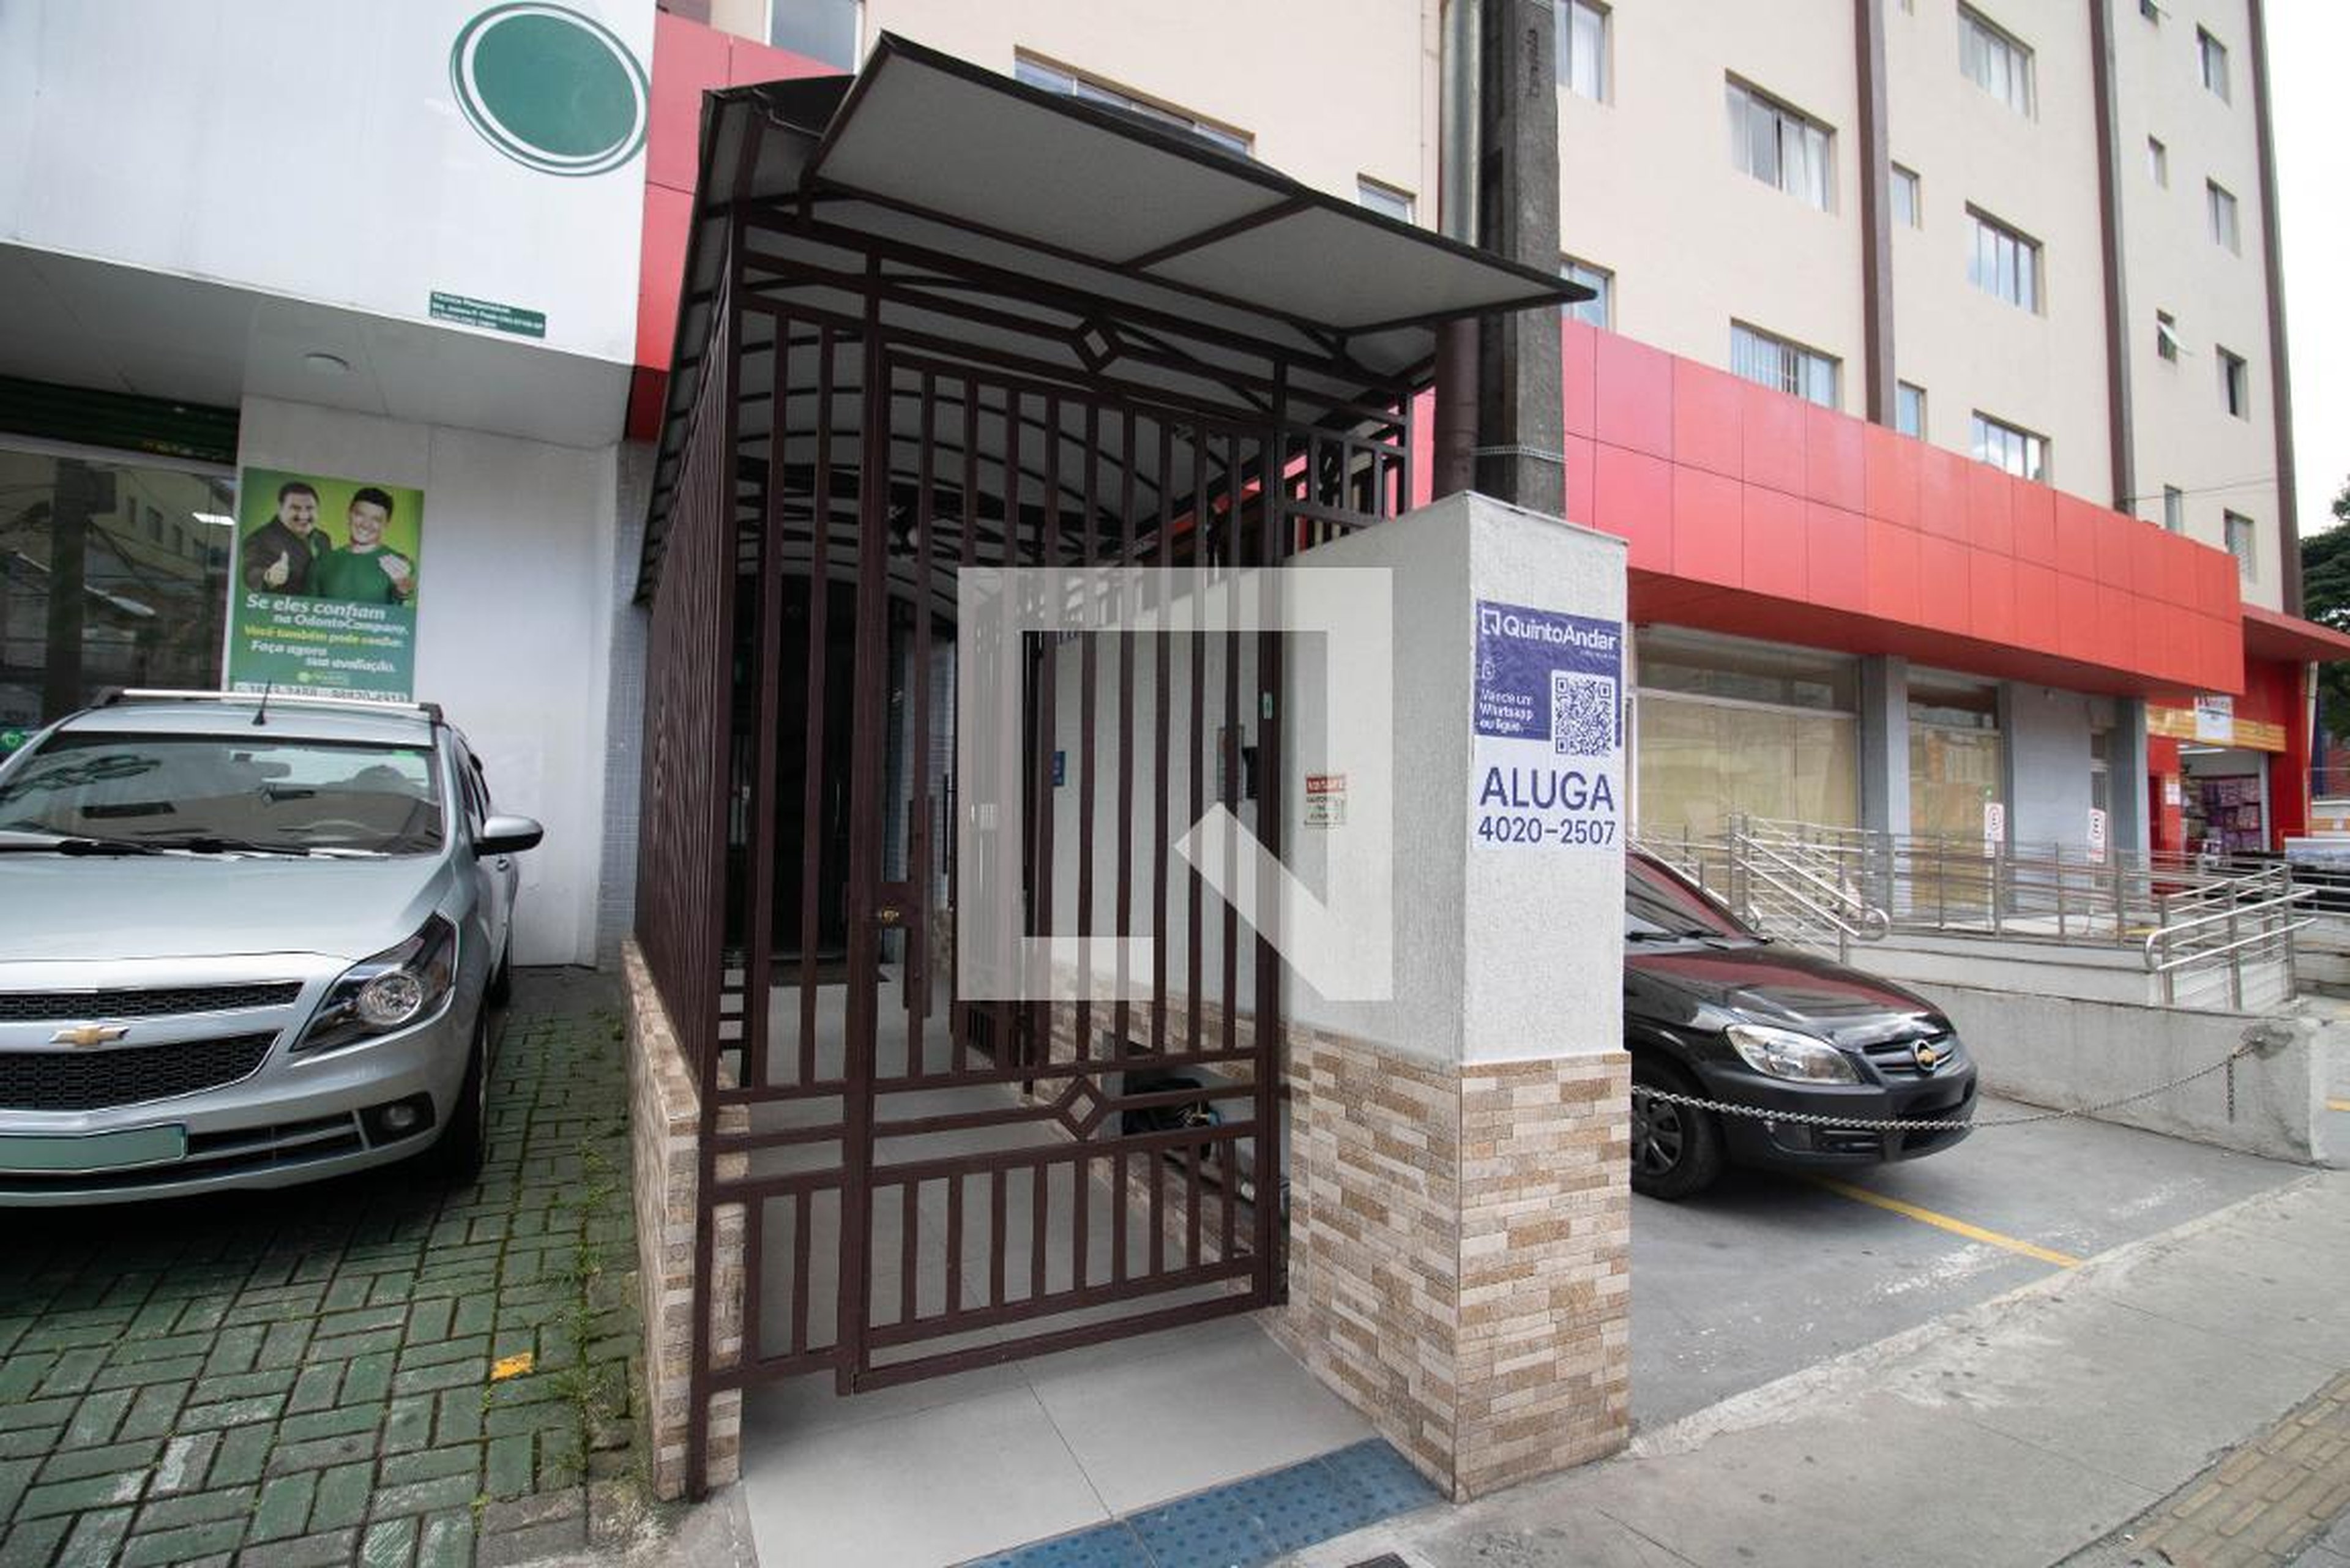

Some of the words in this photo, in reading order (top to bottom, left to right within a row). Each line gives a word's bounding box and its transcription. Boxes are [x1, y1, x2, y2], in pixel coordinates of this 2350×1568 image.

[247, 594, 269, 610] Se
[273, 597, 310, 612] eles
[313, 602, 386, 621] confiam
[273, 614, 291, 625] na
[1503, 615, 1616, 650] QuintoAndar
[251, 640, 284, 654] Faça
[1480, 720, 1494, 730] ou
[1480, 767, 1614, 812] ALUGA
[1479, 816, 1616, 845] 4020-2507
